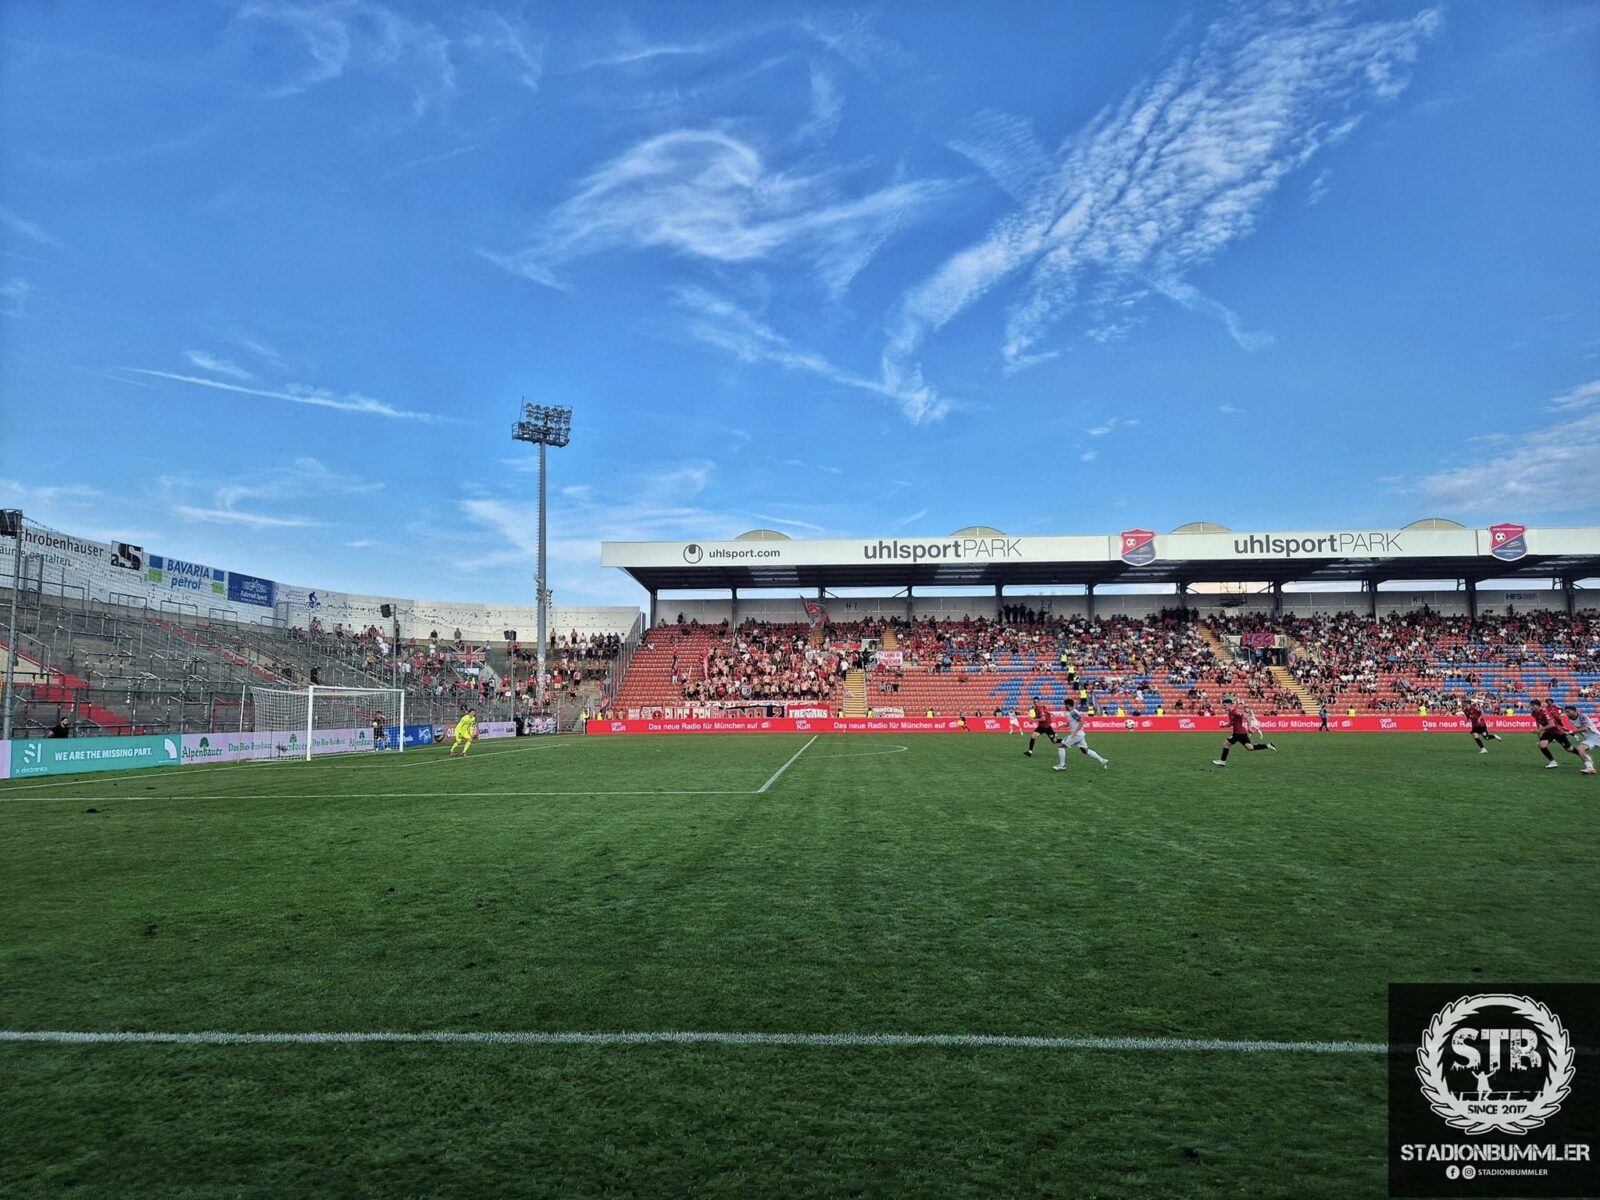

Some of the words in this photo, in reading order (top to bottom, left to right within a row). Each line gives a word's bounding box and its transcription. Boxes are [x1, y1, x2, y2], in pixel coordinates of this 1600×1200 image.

[864, 538, 1022, 562] uhlsportPARK
[1234, 532, 1404, 557] uhlsportPARK
[709, 548, 781, 559] uhlsport.com
[167, 559, 210, 579] BAVARIA
[171, 576, 201, 591] petrol
[681, 722, 702, 730] Radio
[714, 721, 746, 729] München
[889, 721, 899, 729] für
[901, 721, 932, 729] München
[1278, 720, 1289, 728] für
[1423, 720, 1437, 728] Das
[1496, 720, 1531, 728] München
[55, 751, 69, 761] WE
[69, 750, 85, 760] ARE
[86, 749, 101, 759] THE
[102, 748, 133, 758] MISSING
[134, 747, 153, 756] PART.
[182, 745, 223, 761] Alpenbauer
